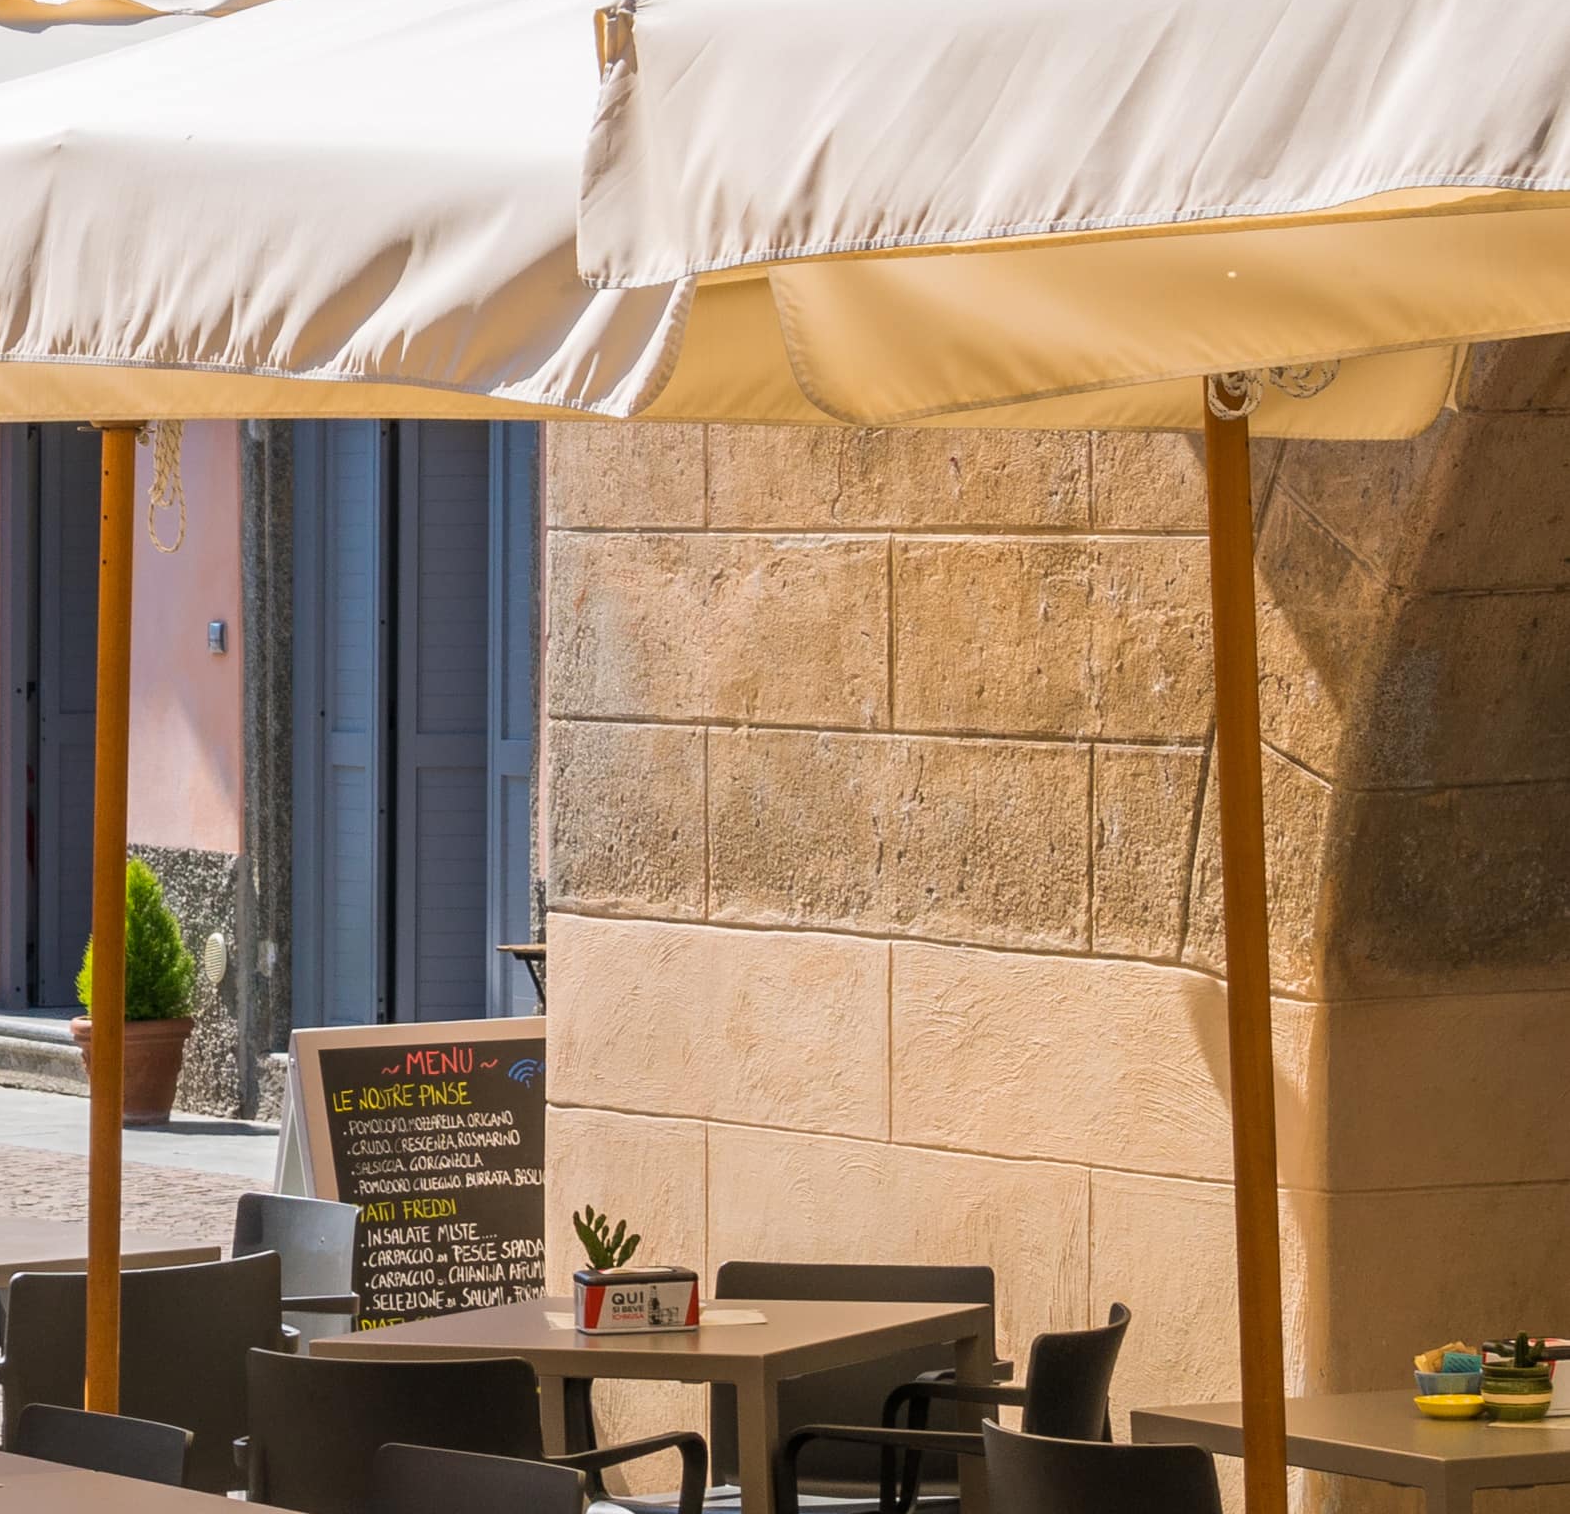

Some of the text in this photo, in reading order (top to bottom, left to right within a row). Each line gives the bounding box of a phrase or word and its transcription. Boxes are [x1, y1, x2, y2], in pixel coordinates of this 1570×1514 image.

[405, 1046, 474, 1075] MENU
[332, 1081, 473, 1113] LE NOSTRE PINSE
[467, 1110, 514, 1128] ORIGANO
[457, 1129, 521, 1148] ROSMARINO
[409, 1152, 484, 1172] GORGONZOLA
[353, 1198, 457, 1223] IATTI FREDDI
[367, 1225, 432, 1248] INSALATE
[368, 1246, 435, 1268] CARPACCIO
[451, 1241, 498, 1264] PESCE
[500, 1238, 546, 1260] SPADA
[370, 1269, 436, 1290] CARPACCIO
[372, 1289, 446, 1312] SELEZIONE
[460, 1285, 505, 1308] SALUMI
[611, 1291, 644, 1305] QUI
